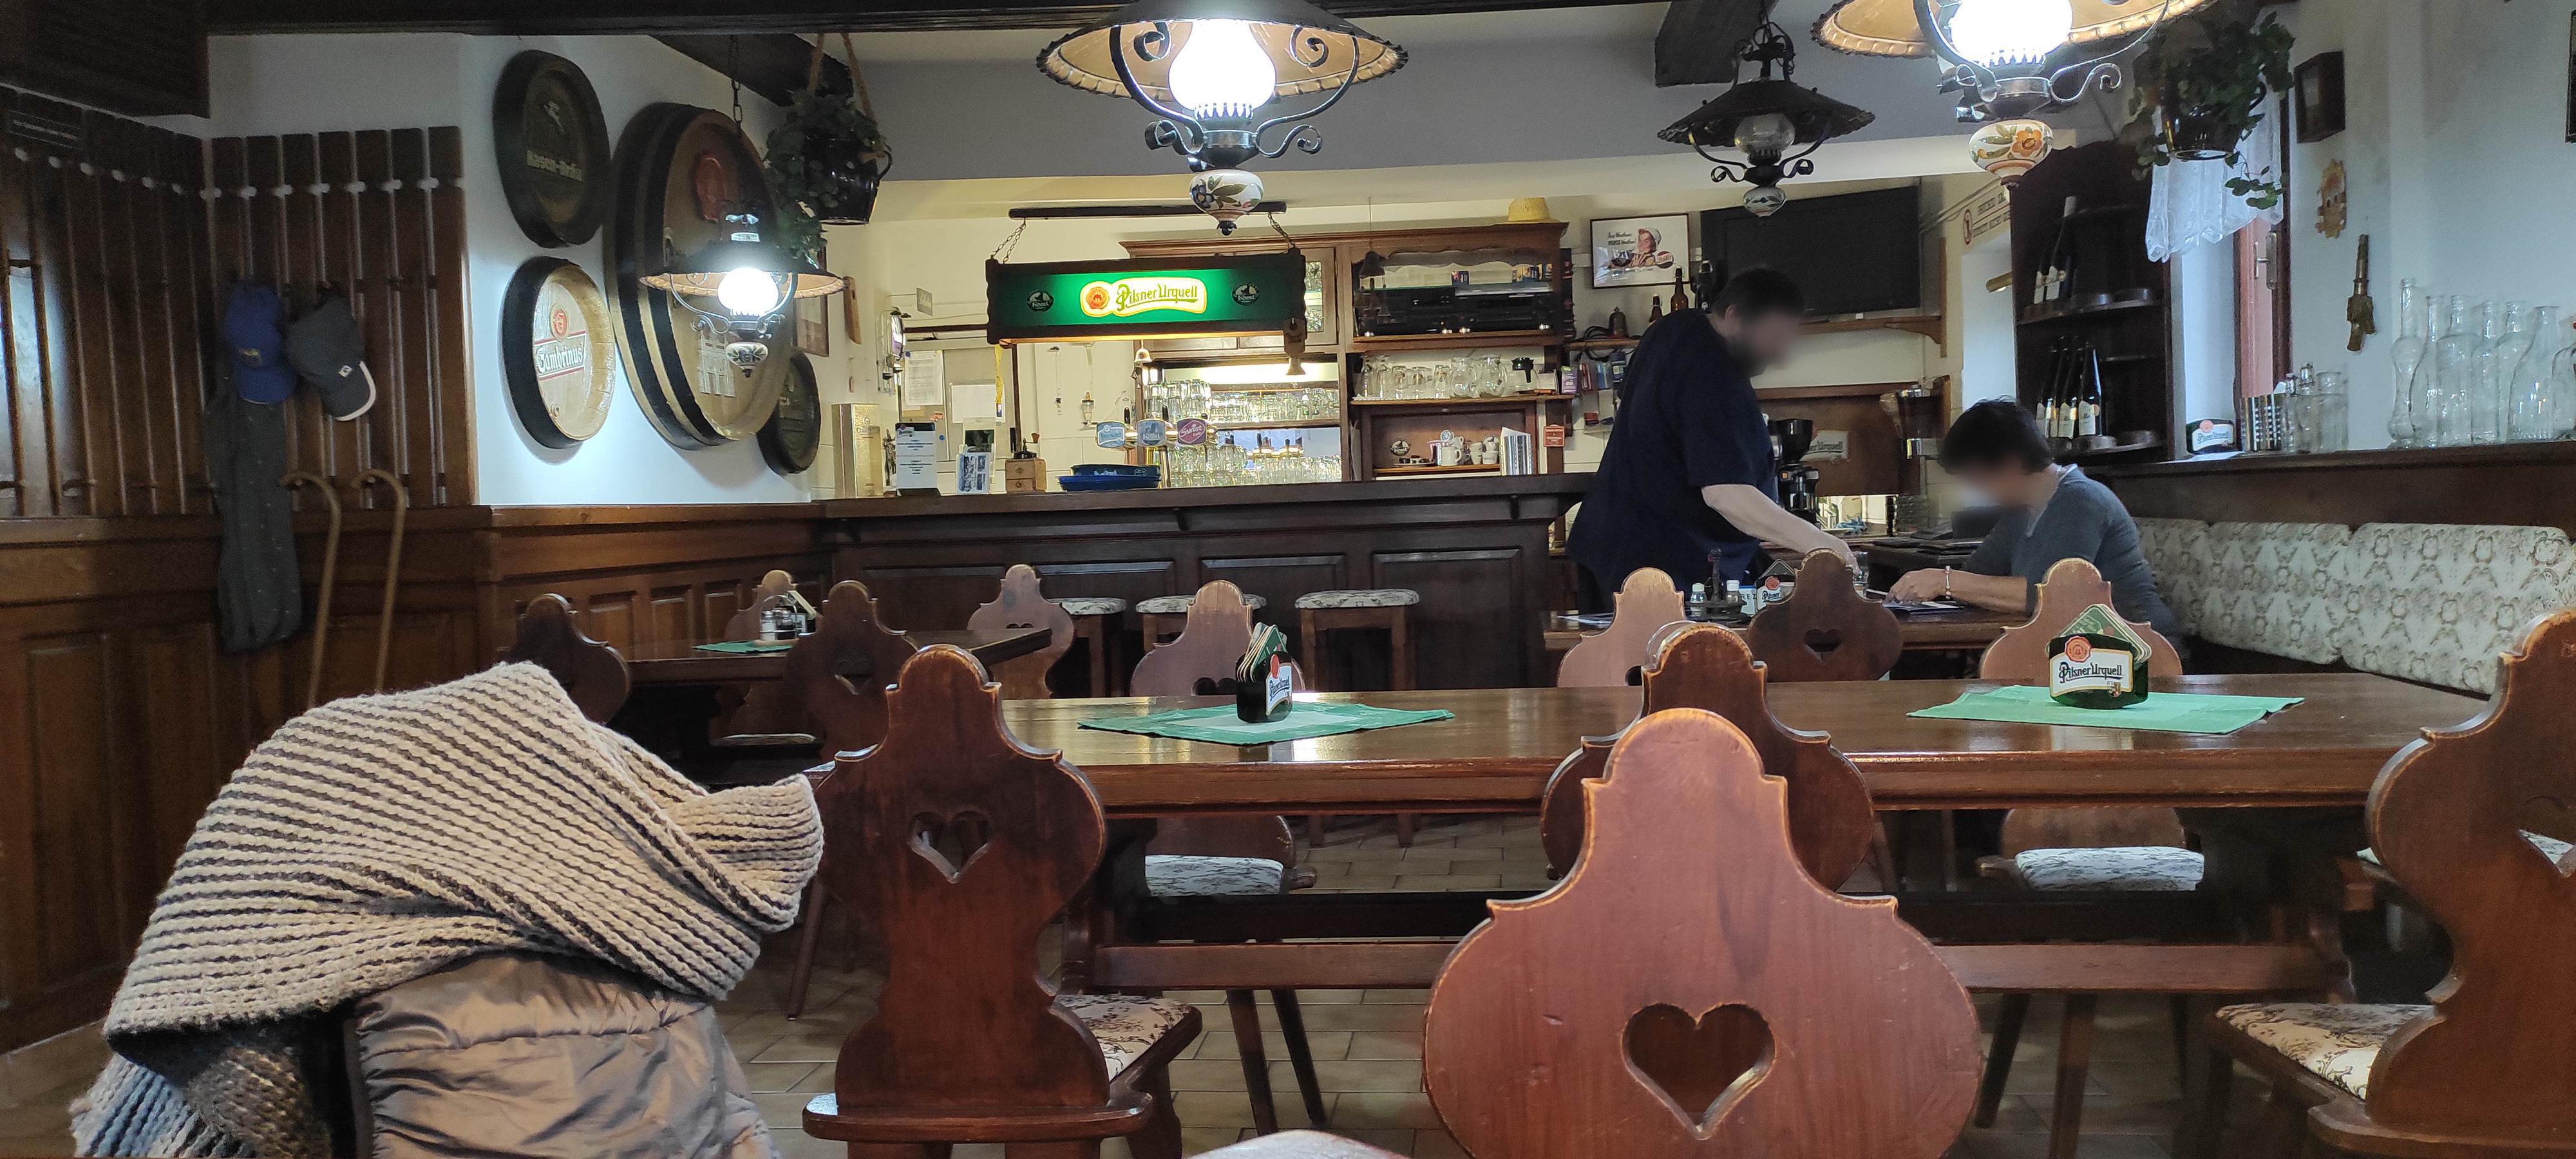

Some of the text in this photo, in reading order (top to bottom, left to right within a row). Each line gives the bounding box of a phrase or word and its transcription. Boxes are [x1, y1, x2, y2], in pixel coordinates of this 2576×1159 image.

[1116, 283, 1197, 311] Pilsner Urquell
[535, 343, 583, 373] Gambrinus
[1762, 590, 1780, 603] Pilsner
[2059, 662, 2122, 683] Pilsner Urquell
